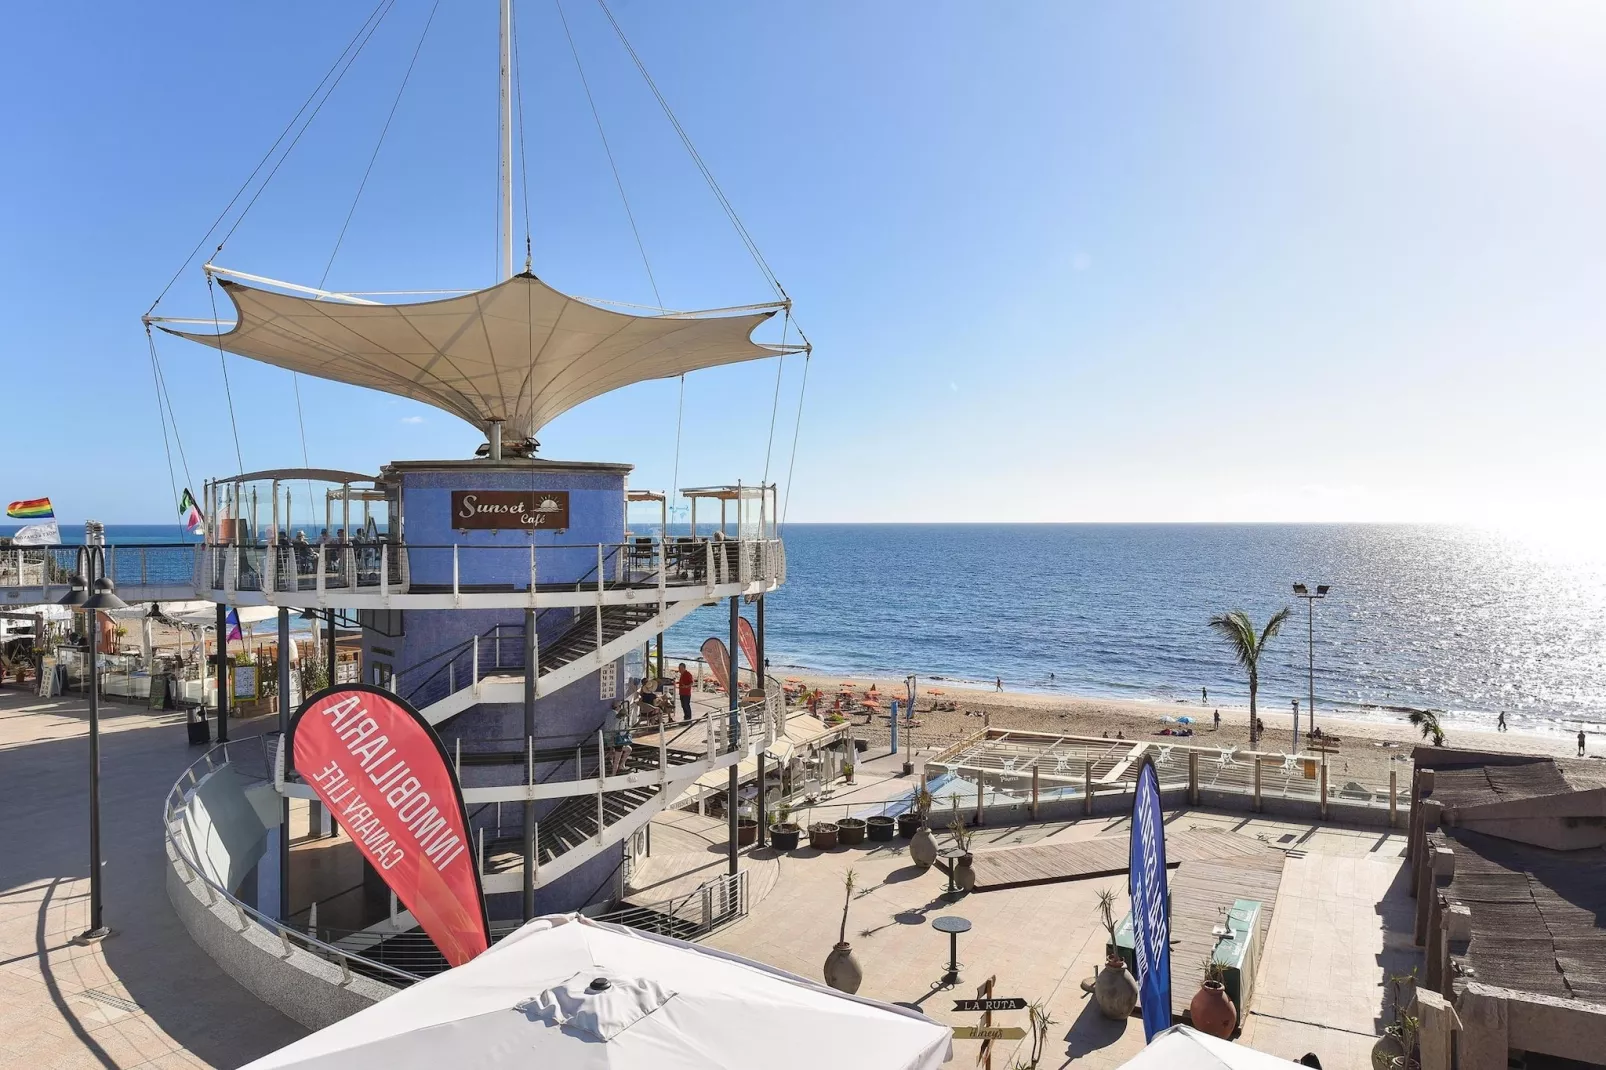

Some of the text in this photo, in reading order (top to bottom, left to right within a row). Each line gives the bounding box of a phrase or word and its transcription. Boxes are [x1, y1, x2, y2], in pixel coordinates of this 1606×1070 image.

[459, 495, 525, 518] Sunset
[520, 513, 546, 526] Café
[964, 1000, 1016, 1010] LA RUTA
